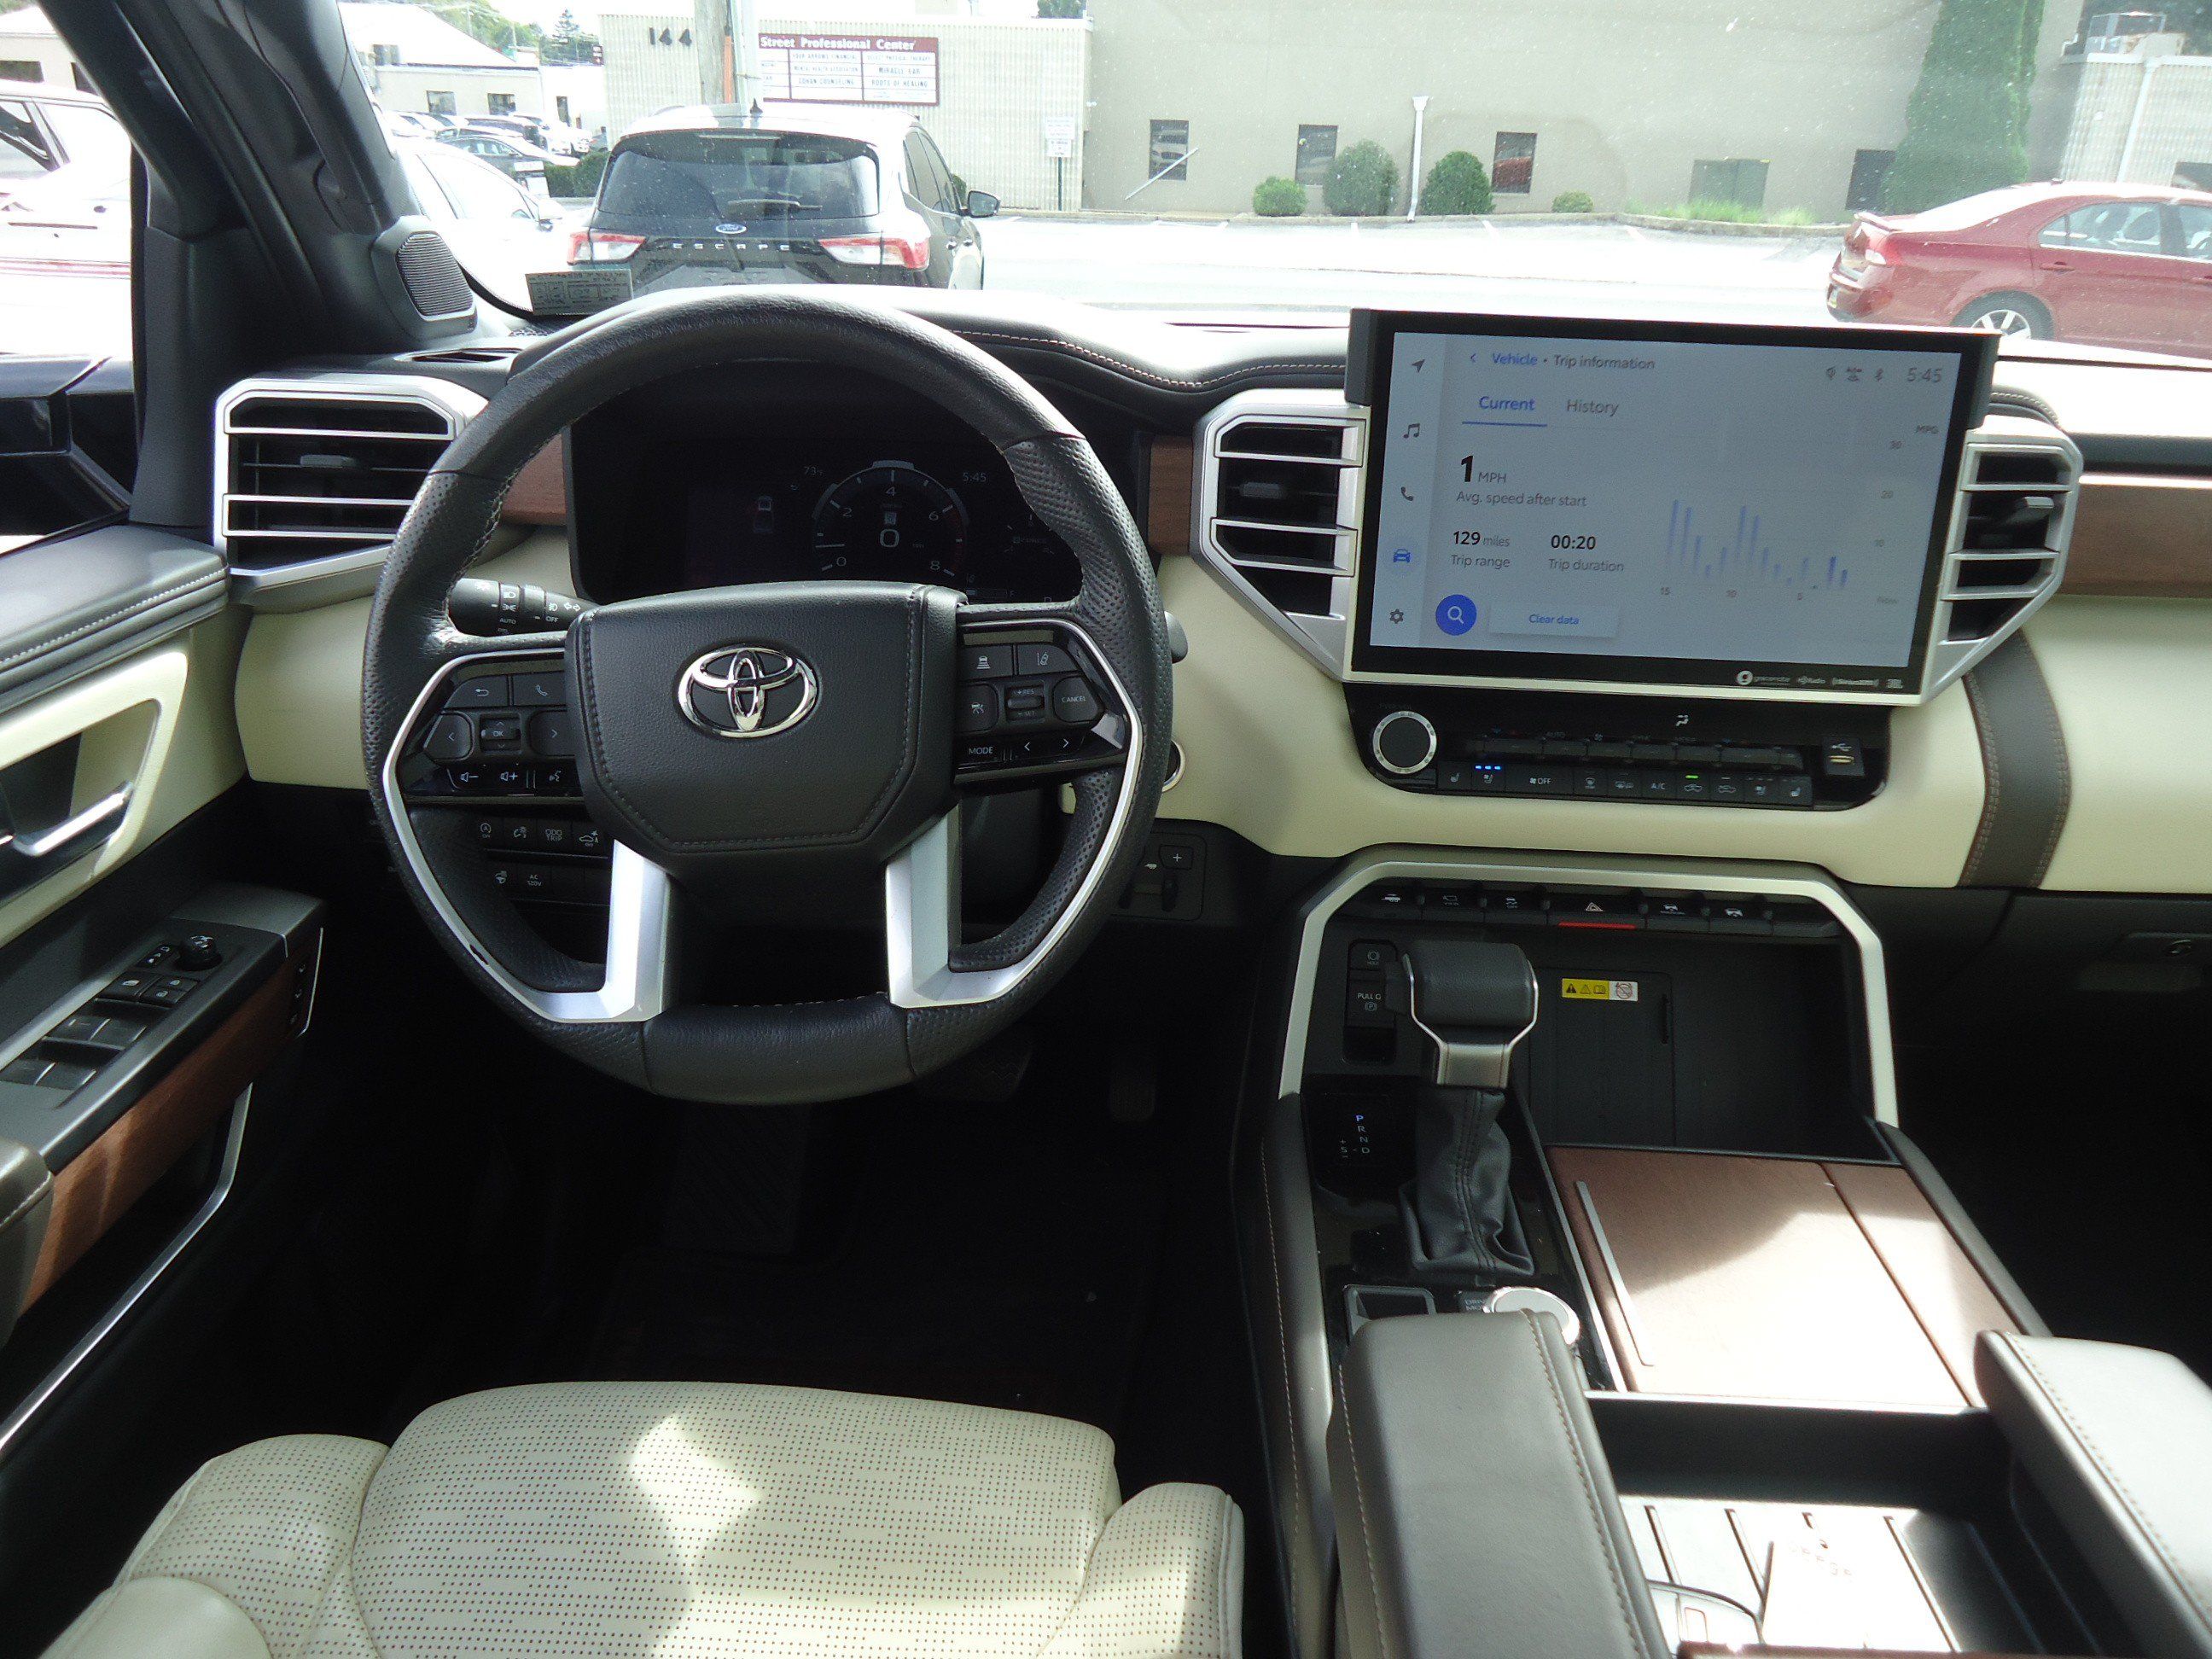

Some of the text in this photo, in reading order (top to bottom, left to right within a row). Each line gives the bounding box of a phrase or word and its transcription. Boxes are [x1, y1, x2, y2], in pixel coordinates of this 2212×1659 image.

[649, 26, 692, 46] 144
[760, 36, 916, 51] Street Professional Center
[672, 242, 790, 251] ESCAPE
[1492, 352, 1656, 370] Vehicle Trip information
[1479, 395, 1619, 417] Current History
[1461, 455, 1507, 484] 1 MPH
[885, 486, 897, 497] 4
[1457, 491, 1587, 507] Avg. speed after start
[841, 507, 853, 518] 2
[928, 510, 940, 521] 6
[1453, 530, 1511, 547] 129 miles
[1551, 534, 1597, 550] 00:20
[929, 560, 940, 571] 8
[1452, 554, 1511, 570] Trip range
[1548, 558, 1625, 573] Trip duration
[1528, 614, 1580, 626] Clear data
[1061, 696, 1086, 704] CANCEL
[968, 746, 994, 756] MODE
[1537, 777, 1552, 785] OFF
[1650, 782, 1666, 790] A/C
[1357, 992, 1374, 1000] PULL
